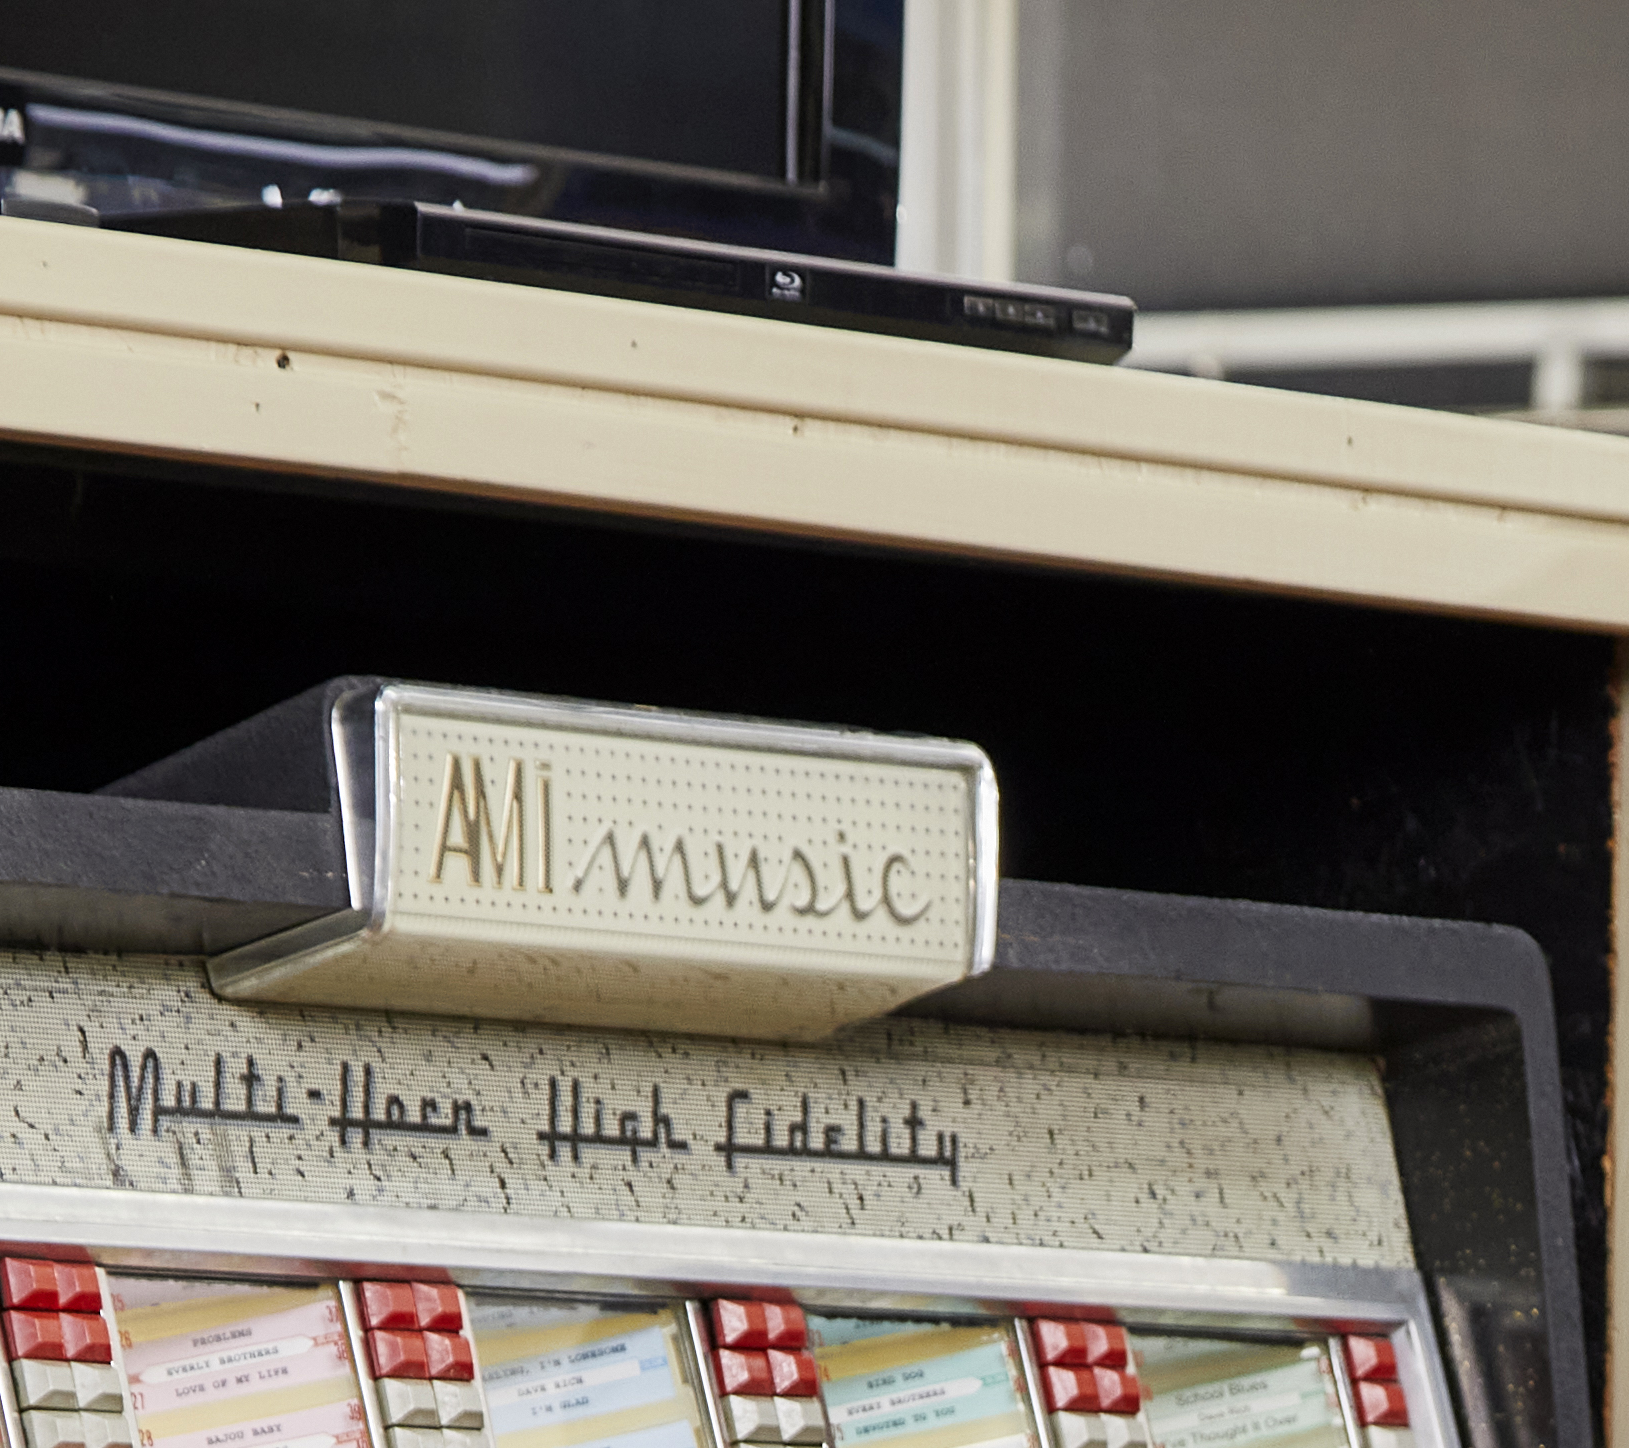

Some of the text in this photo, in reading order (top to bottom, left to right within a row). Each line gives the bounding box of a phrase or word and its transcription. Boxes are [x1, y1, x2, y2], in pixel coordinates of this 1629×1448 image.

[572, 828, 933, 926] music
[537, 1074, 689, 1166] High
[713, 1088, 960, 1188] Fidelity
[191, 1327, 253, 1348] PROBLEMS
[166, 1346, 279, 1376] EVERLY BROTHERS
[174, 1382, 206, 1397] LOVE
[235, 1373, 251, 1385] MY
[258, 1366, 289, 1381] LIFE
[131, 1392, 145, 1410] 27
[139, 1429, 153, 1446] 28
[251, 1423, 283, 1438] BABY
